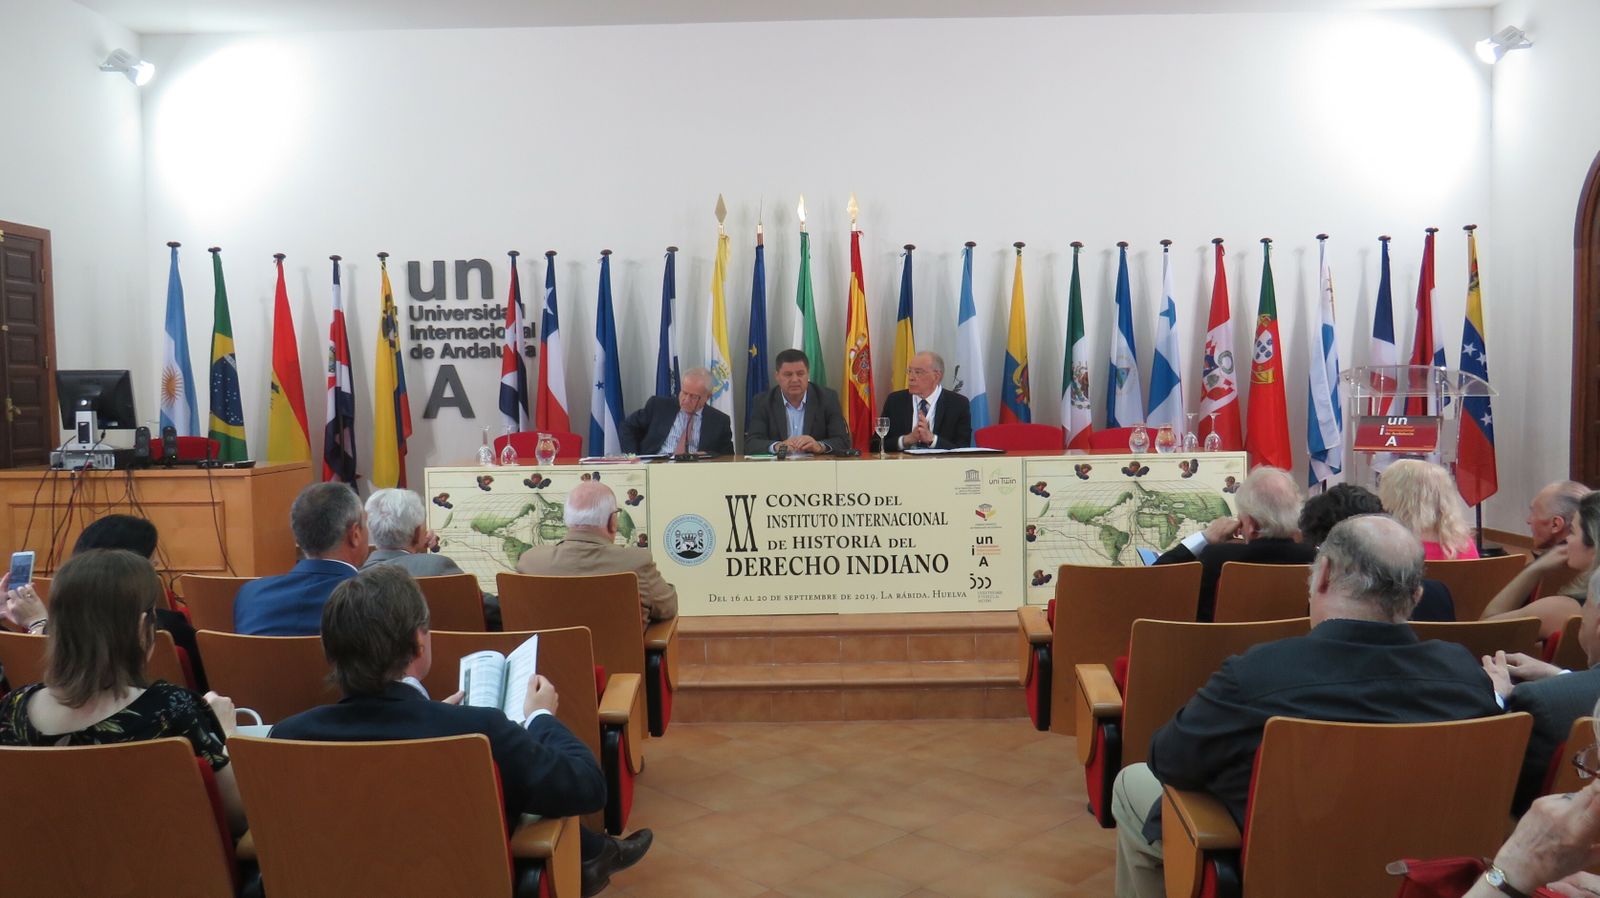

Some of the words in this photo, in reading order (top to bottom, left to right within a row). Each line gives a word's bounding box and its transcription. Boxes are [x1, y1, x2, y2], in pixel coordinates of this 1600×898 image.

[408, 258, 494, 301] un
[409, 304, 526, 321] Universida
[410, 322, 536, 340] Internacioal
[410, 344, 435, 359] de
[440, 342, 536, 359] Andalua
[423, 364, 476, 419] A
[1388, 417, 1408, 425] un
[1380, 425, 1384, 435] i
[1385, 436, 1397, 446] A
[766, 493, 871, 508] CONGRESO
[874, 496, 902, 506] DEL
[725, 494, 758, 552] XX
[767, 514, 838, 528] INSTITUTO
[842, 512, 948, 527] INTERNACIONAL
[768, 540, 788, 550] DE
[792, 535, 882, 549] HISTORIA
[888, 538, 916, 548] DEL
[976, 536, 993, 544] un
[726, 556, 840, 576] DERECHO
[846, 554, 949, 575] INDIANO
[979, 556, 988, 567] A
